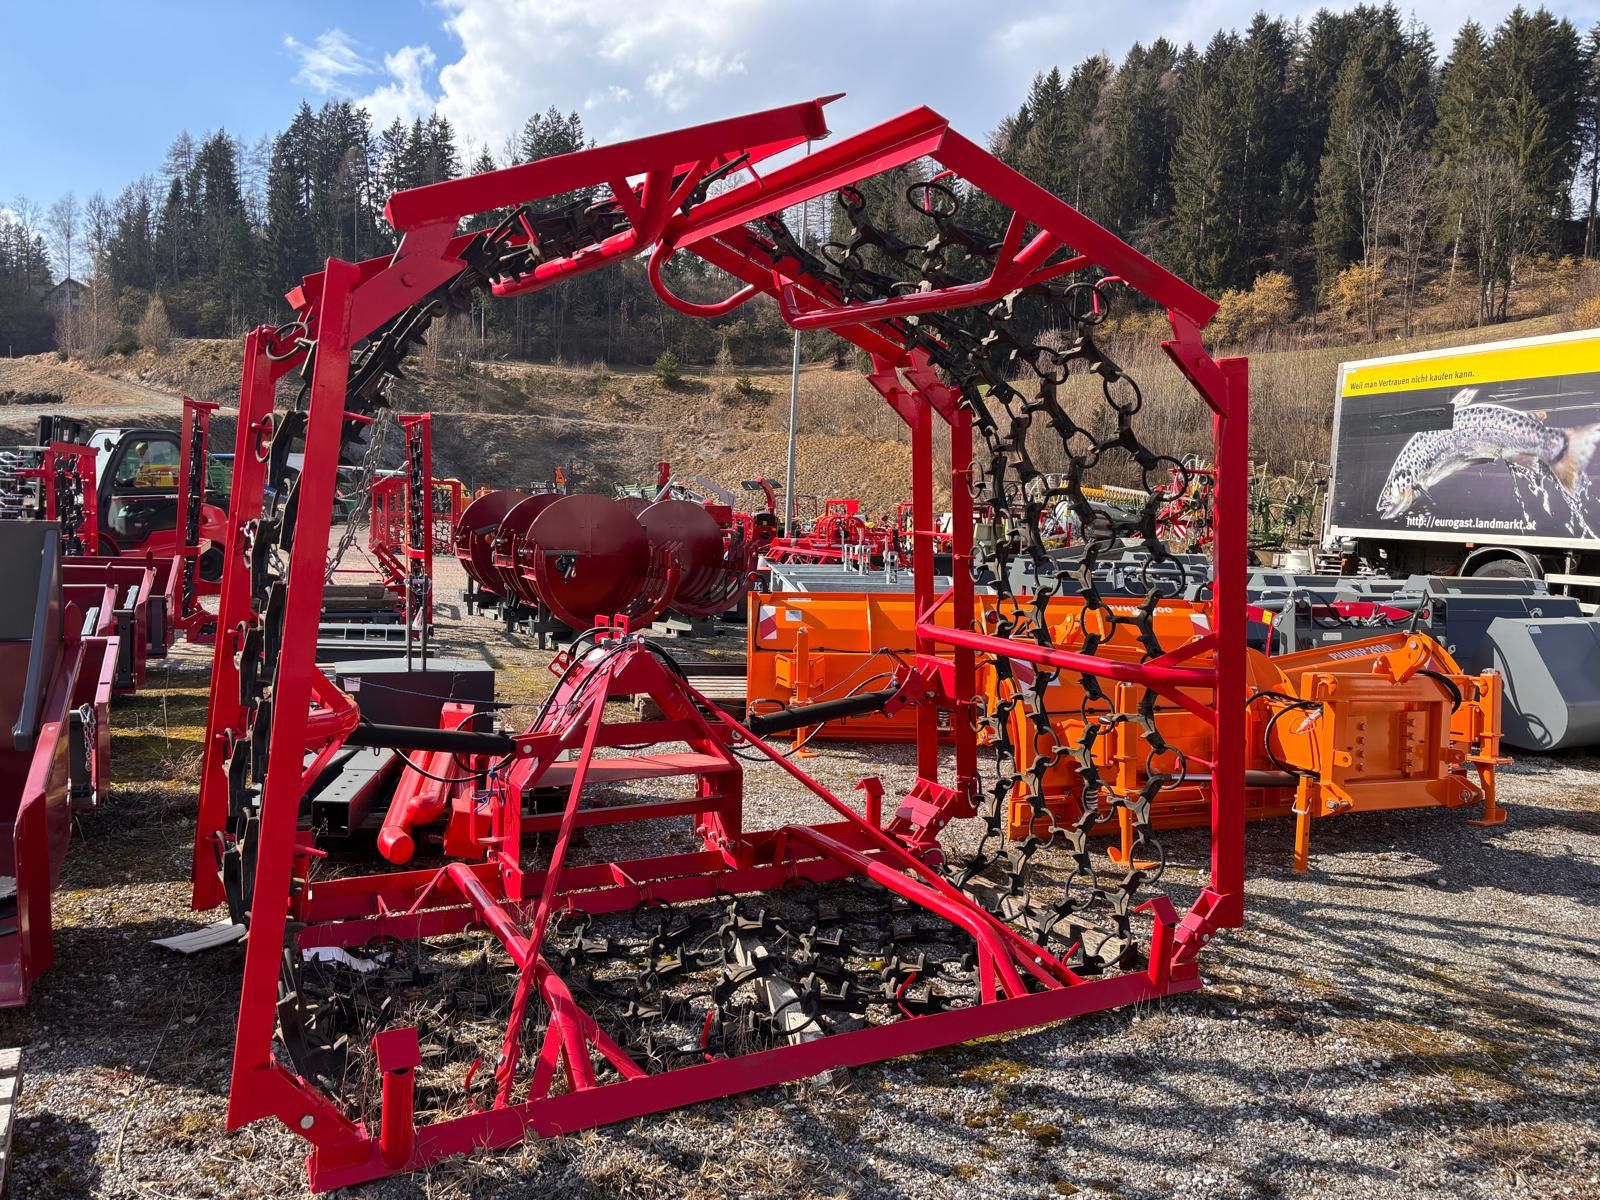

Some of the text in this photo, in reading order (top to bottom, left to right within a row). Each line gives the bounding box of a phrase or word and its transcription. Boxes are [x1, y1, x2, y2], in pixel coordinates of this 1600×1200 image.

[1350, 382, 1363, 390] Weil
[1379, 377, 1410, 387] Vertrauen
[1411, 375, 1428, 384] nicht
[1430, 371, 1453, 381] kaufen
[1455, 370, 1475, 379] kann.
[1406, 515, 1537, 530] http://eurogast.landmarkt.at
